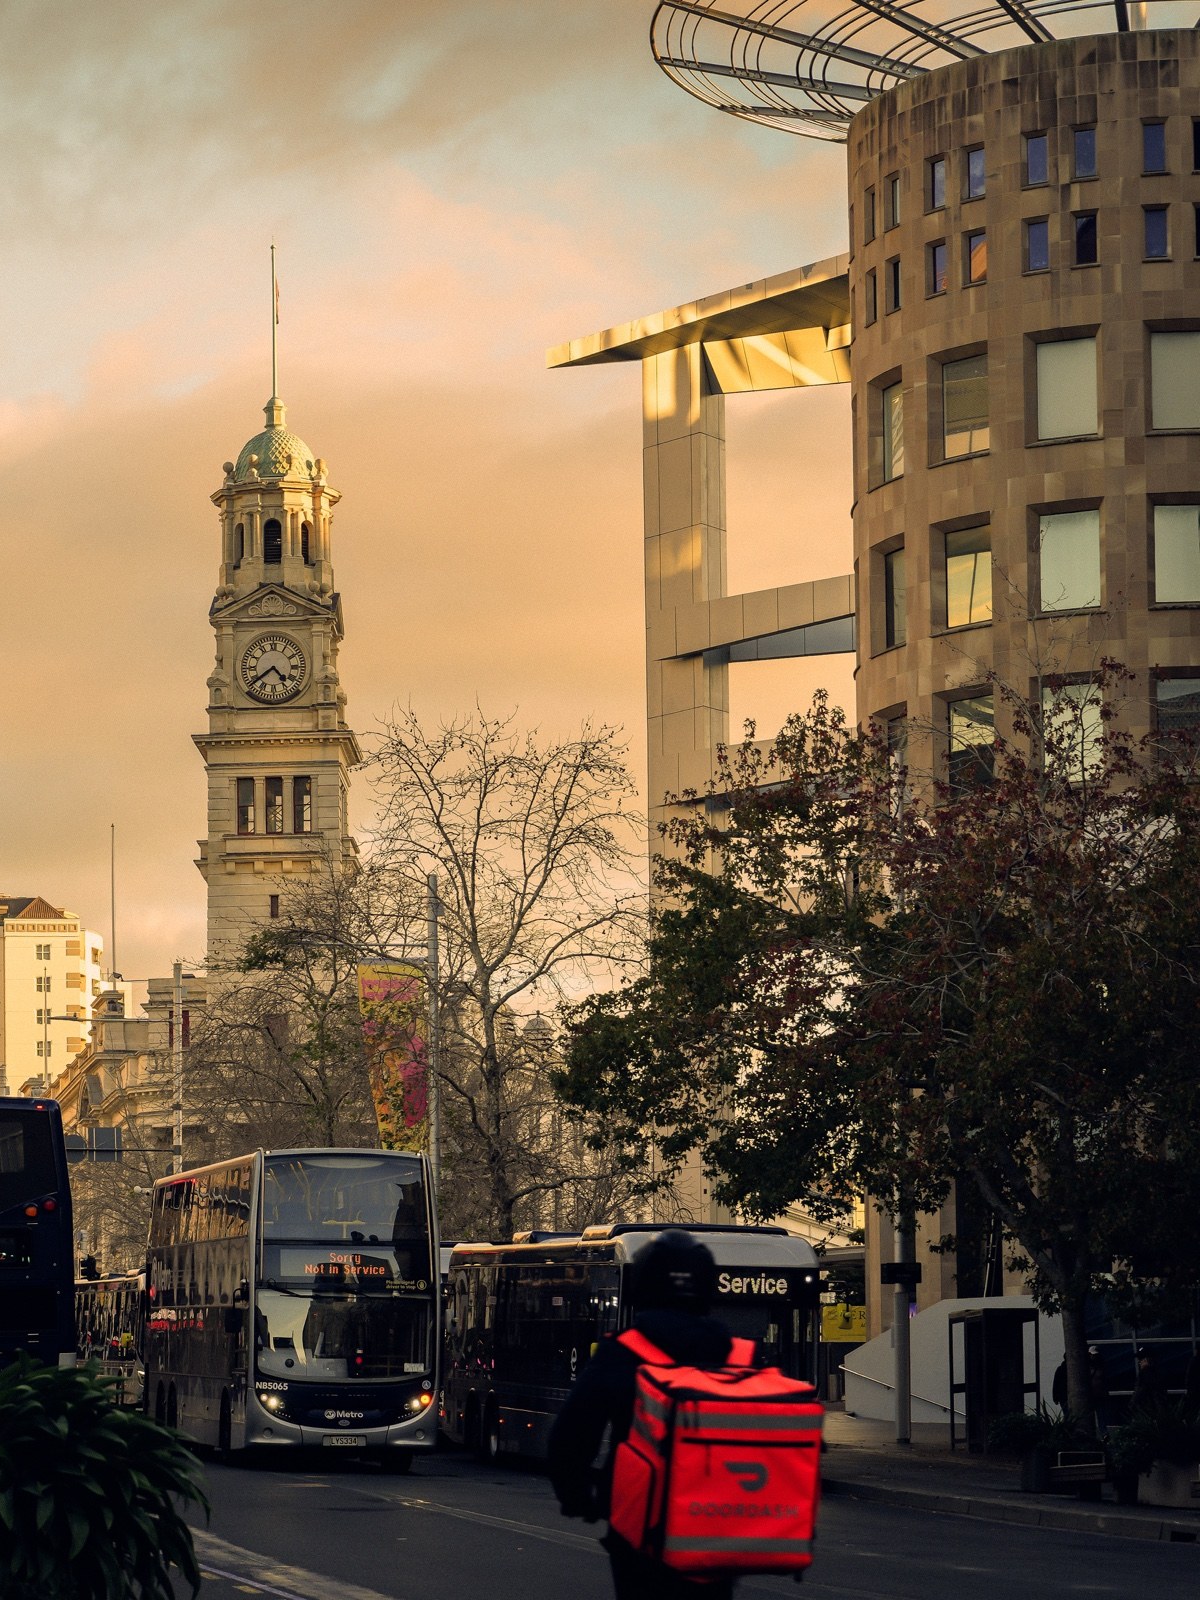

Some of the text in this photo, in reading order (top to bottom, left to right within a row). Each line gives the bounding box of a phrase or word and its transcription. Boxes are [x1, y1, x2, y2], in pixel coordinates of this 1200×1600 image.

[329, 1252, 361, 1264] Sorry
[304, 1264, 386, 1275] Not in Service
[718, 1272, 788, 1295] Service
[255, 1381, 289, 1391] NB5065
[336, 1410, 364, 1418] Metro
[331, 1437, 357, 1445] LYS334
